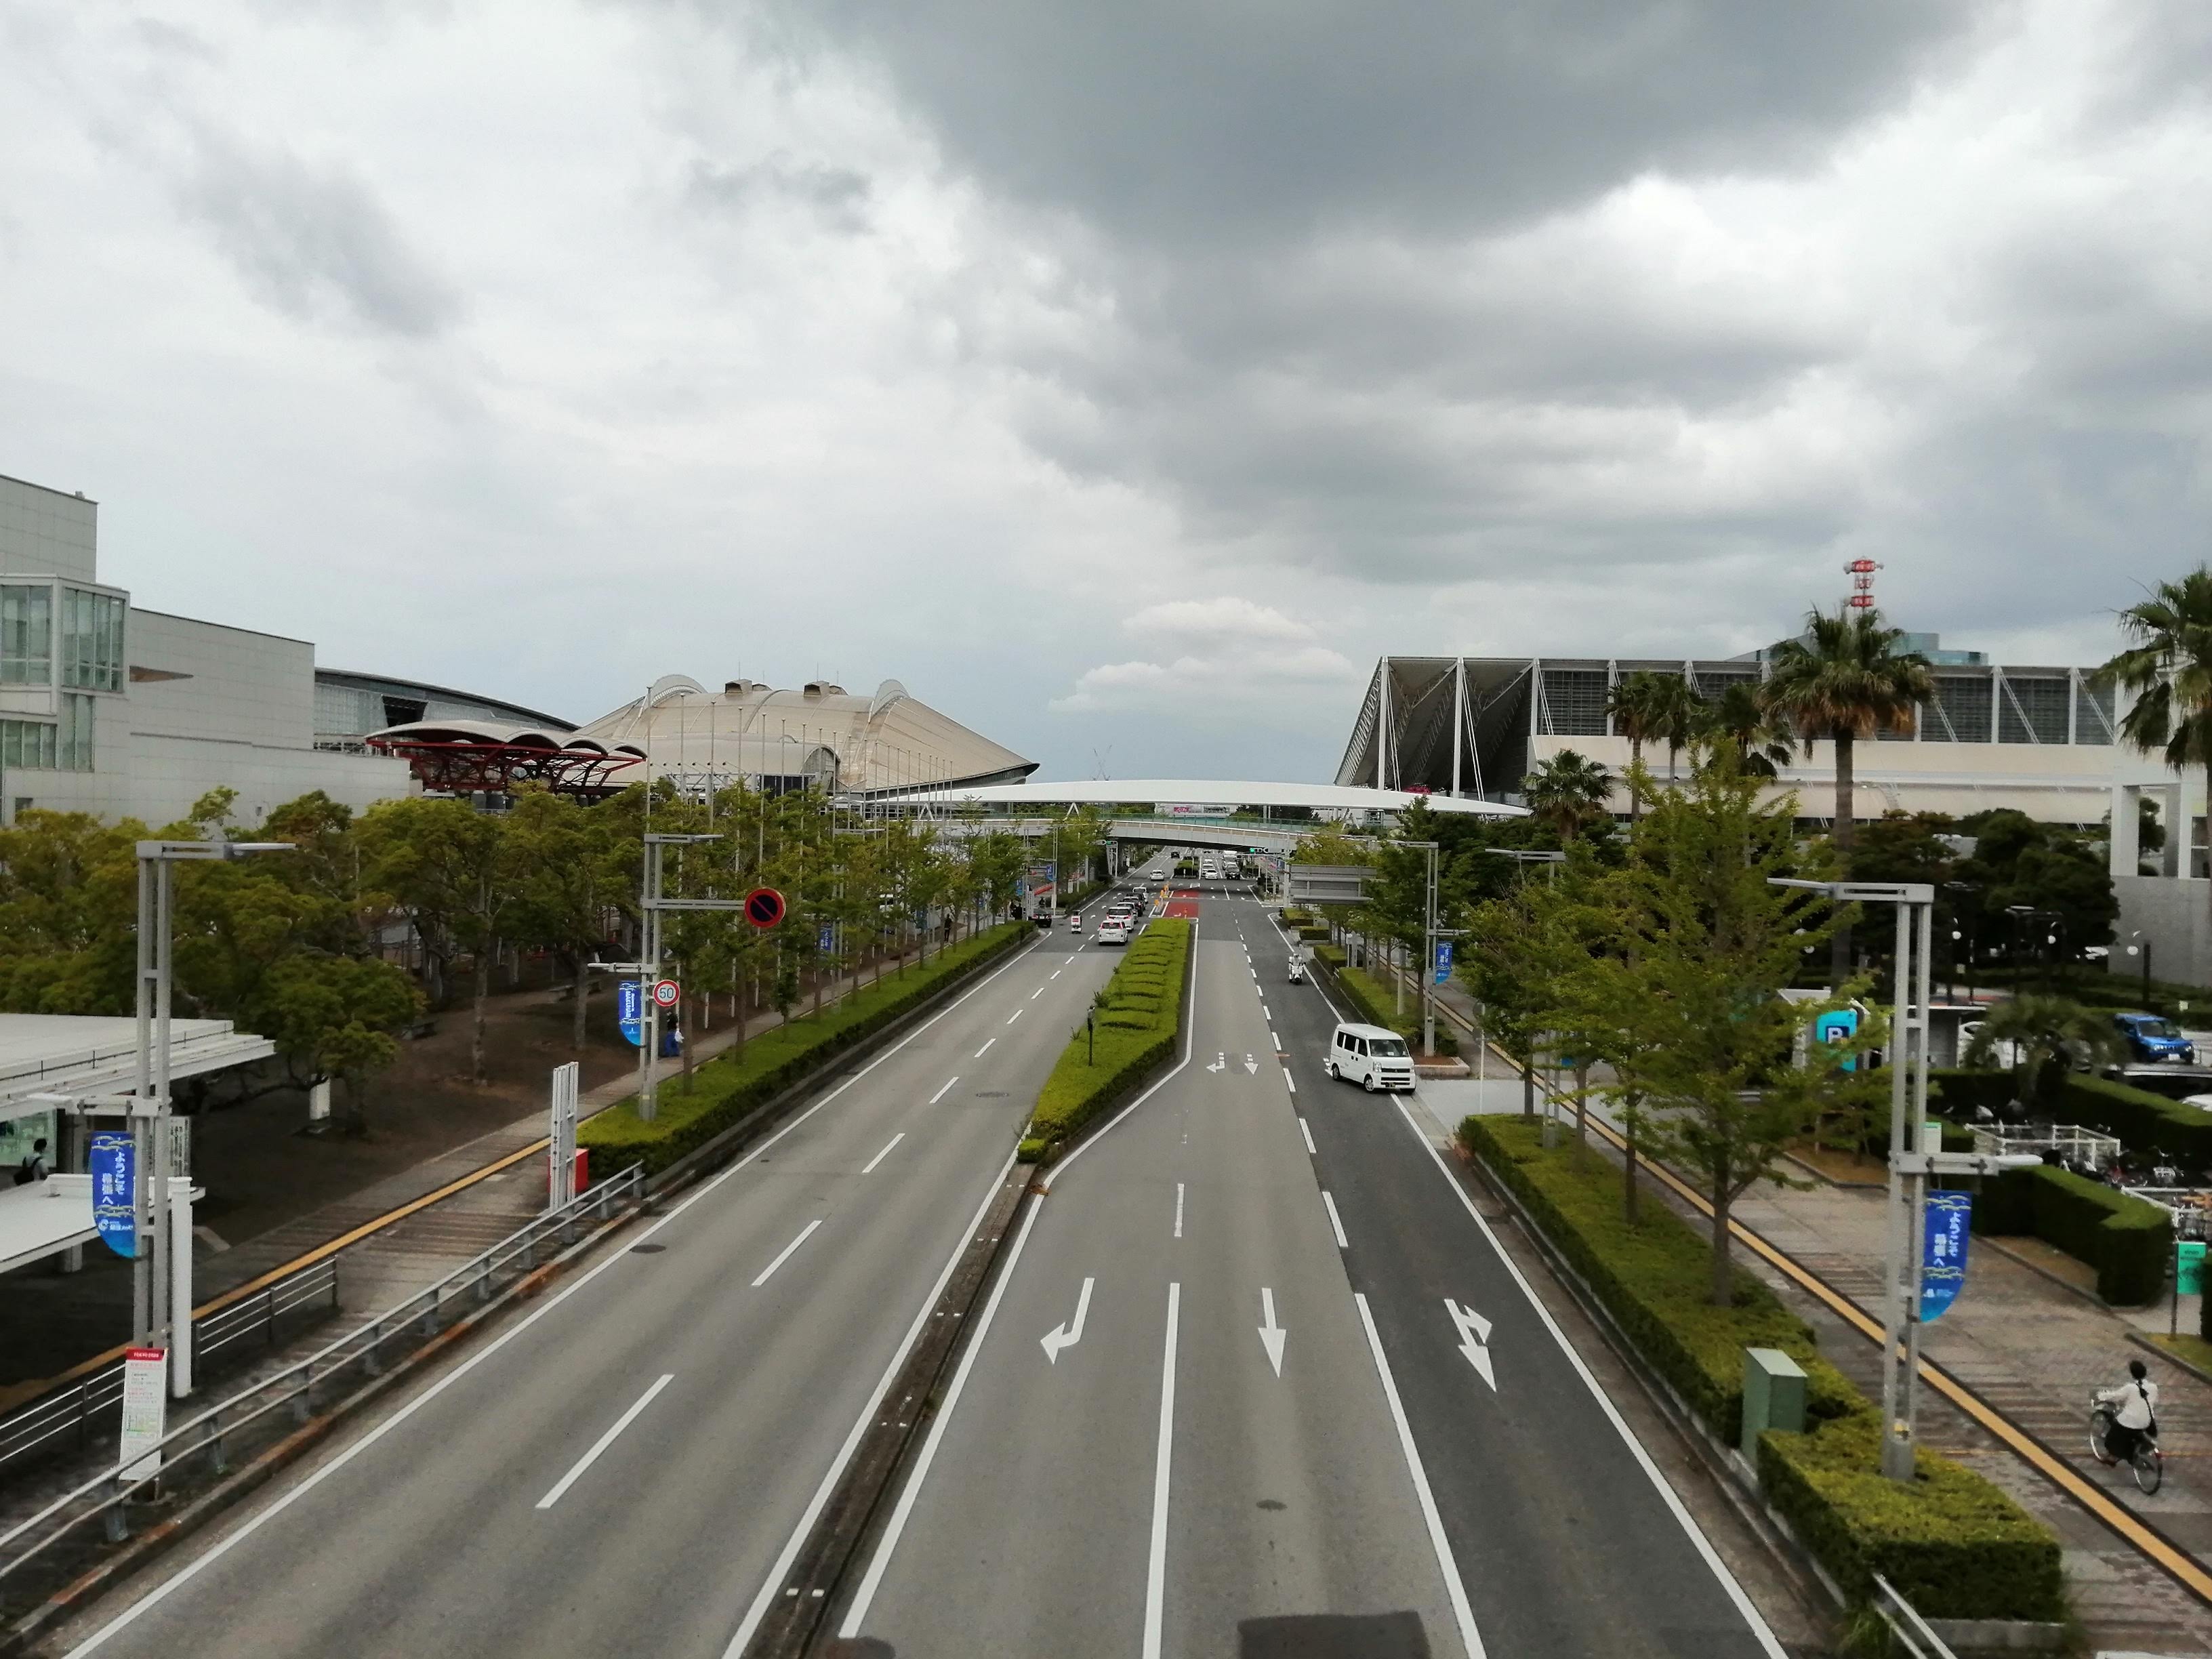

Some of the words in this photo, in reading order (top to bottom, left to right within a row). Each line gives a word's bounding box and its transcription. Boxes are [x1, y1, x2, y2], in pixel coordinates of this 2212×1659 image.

[659, 987, 674, 998] 50
[1828, 1027, 1843, 1044] P
[115, 1151, 125, 1195] ようこそ
